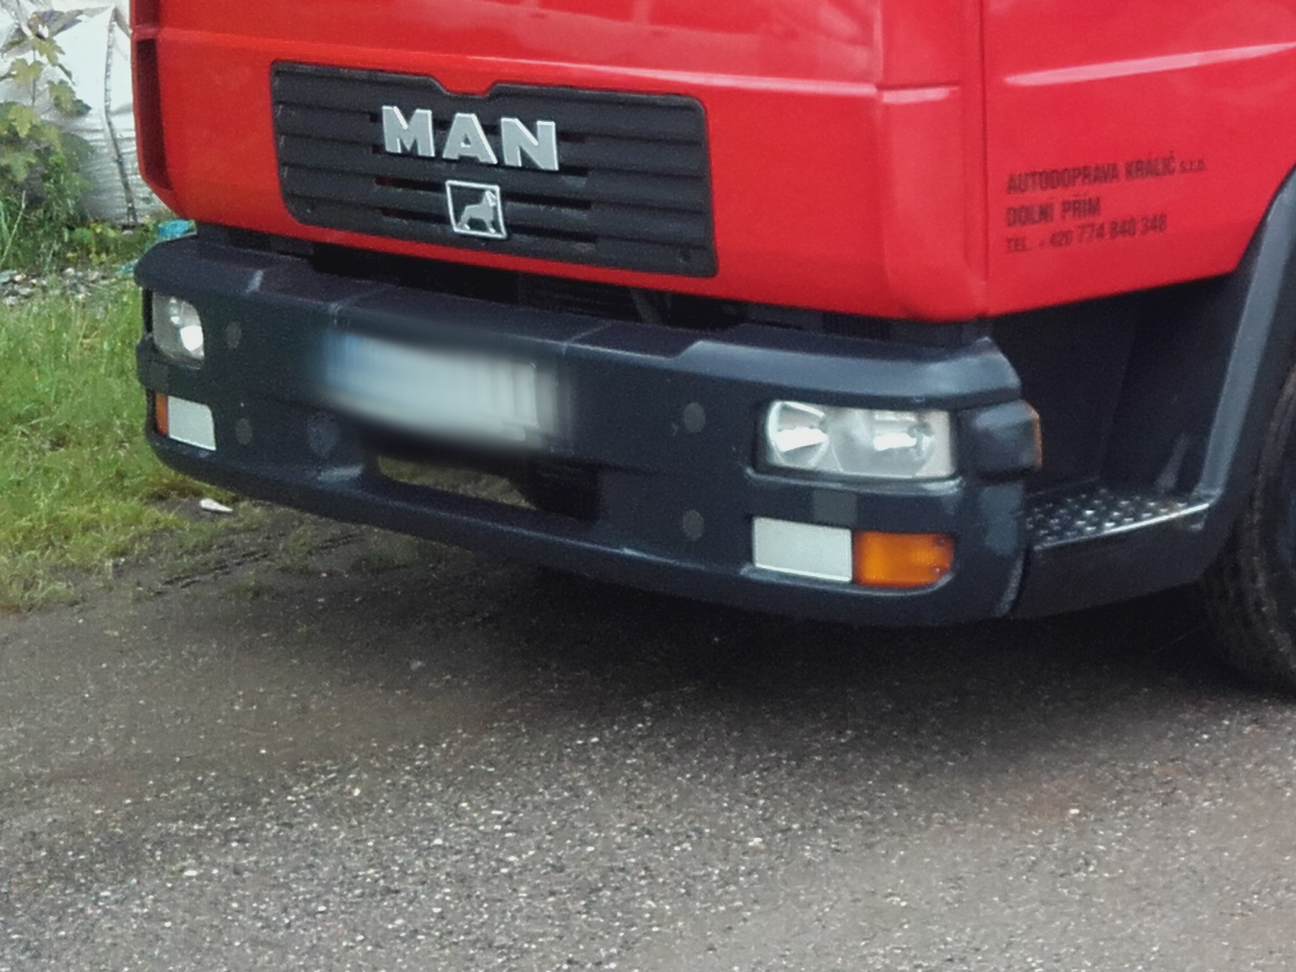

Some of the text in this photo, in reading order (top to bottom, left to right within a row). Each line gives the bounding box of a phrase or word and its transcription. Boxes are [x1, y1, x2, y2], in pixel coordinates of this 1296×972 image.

[382, 105, 560, 171] MAN
[1006, 163, 1119, 194] AUTODOPRAVA
[1078, 222, 1105, 243] 774
